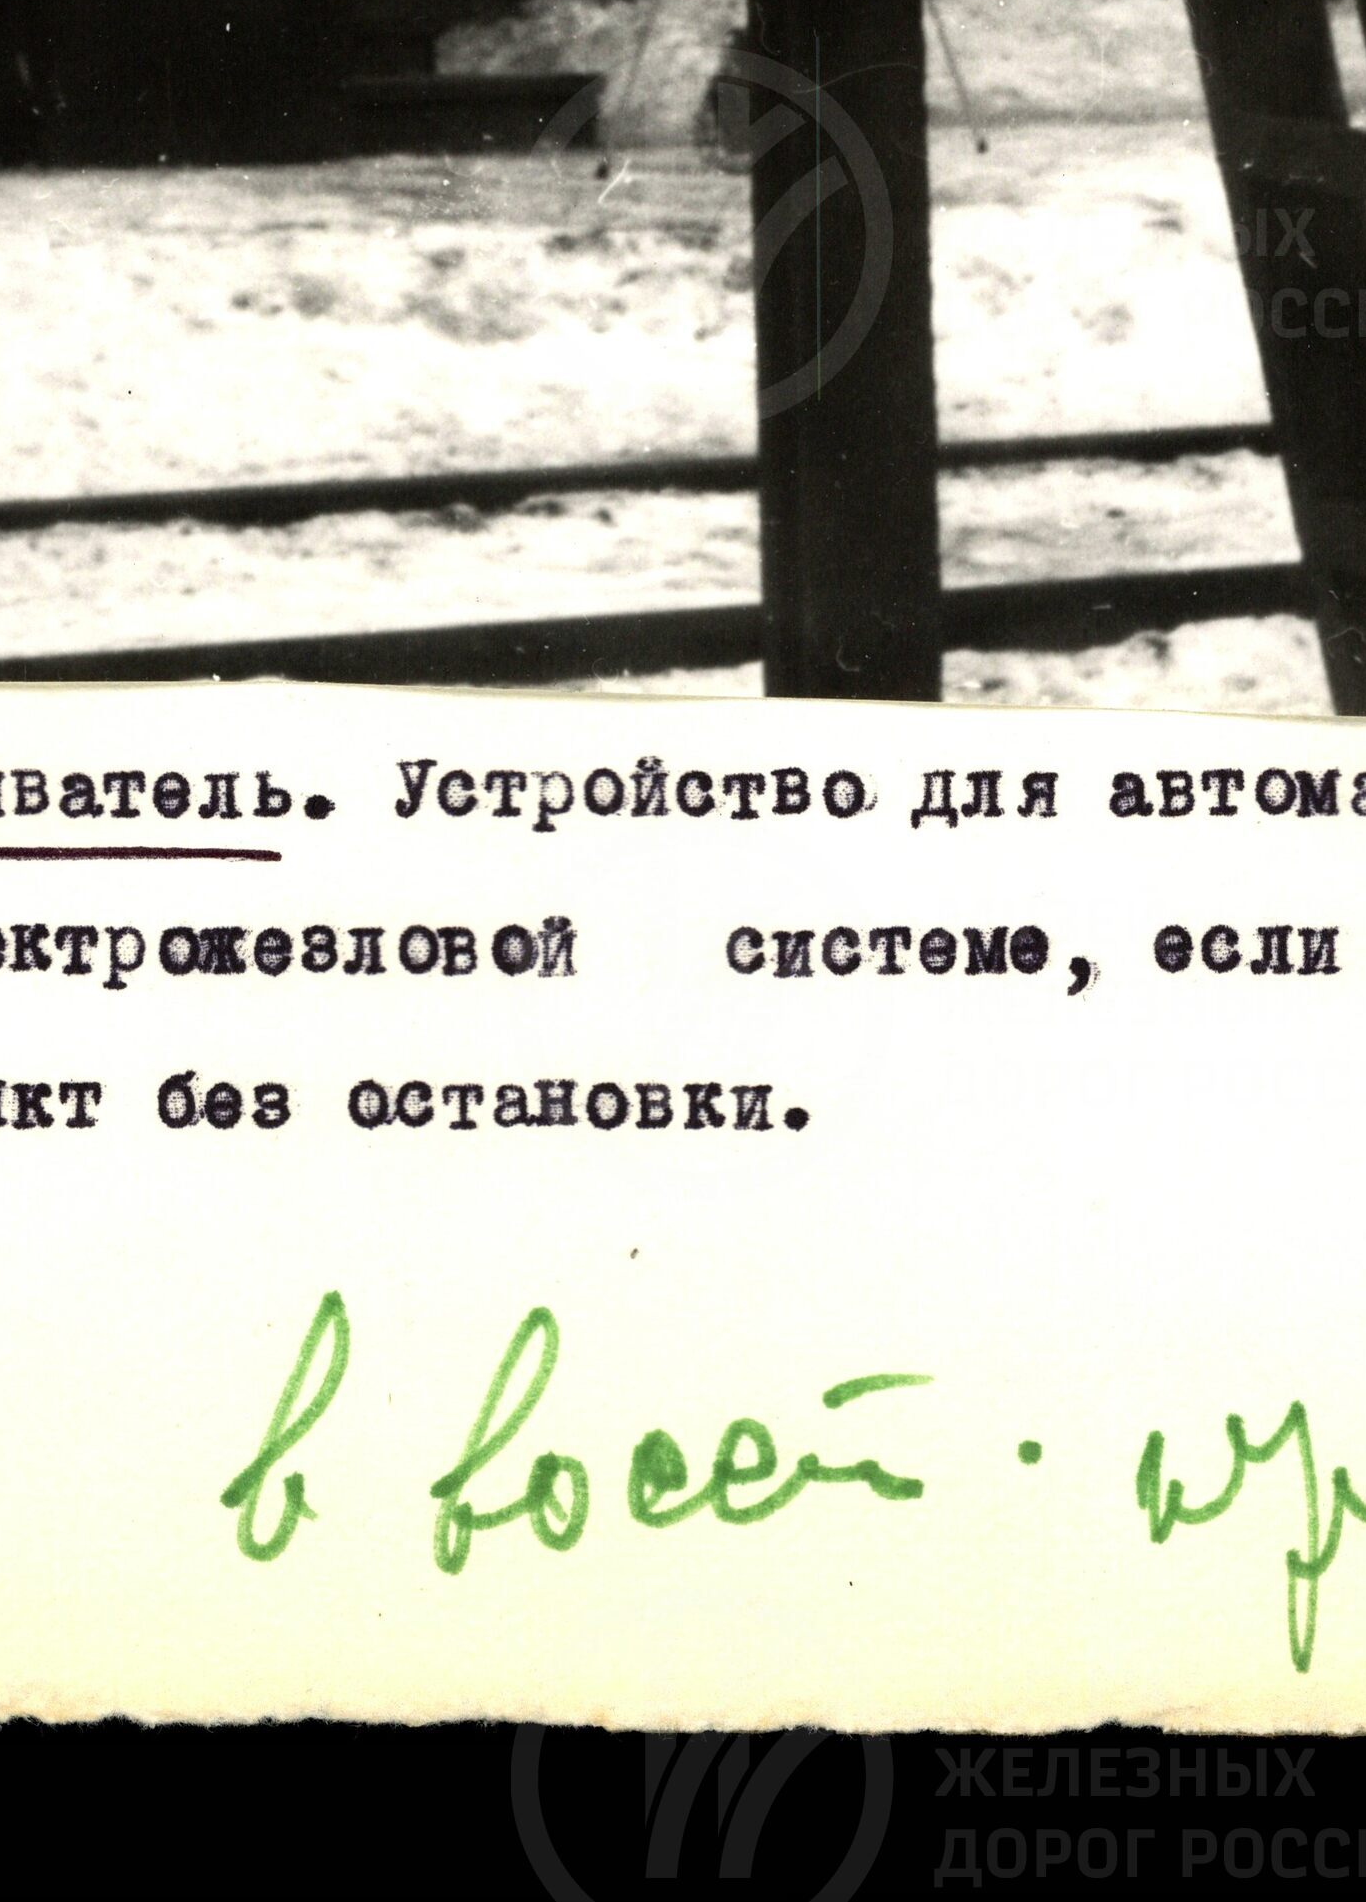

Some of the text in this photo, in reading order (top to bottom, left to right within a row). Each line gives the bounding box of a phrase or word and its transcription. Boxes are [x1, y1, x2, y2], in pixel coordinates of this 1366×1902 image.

[393, 756, 877, 833] Устройство
[910, 768, 1059, 829] для
[725, 924, 1101, 999] системе,
[1152, 923, 1341, 976] если
[156, 1070, 292, 1129] без
[346, 1078, 811, 1132] остановки.
